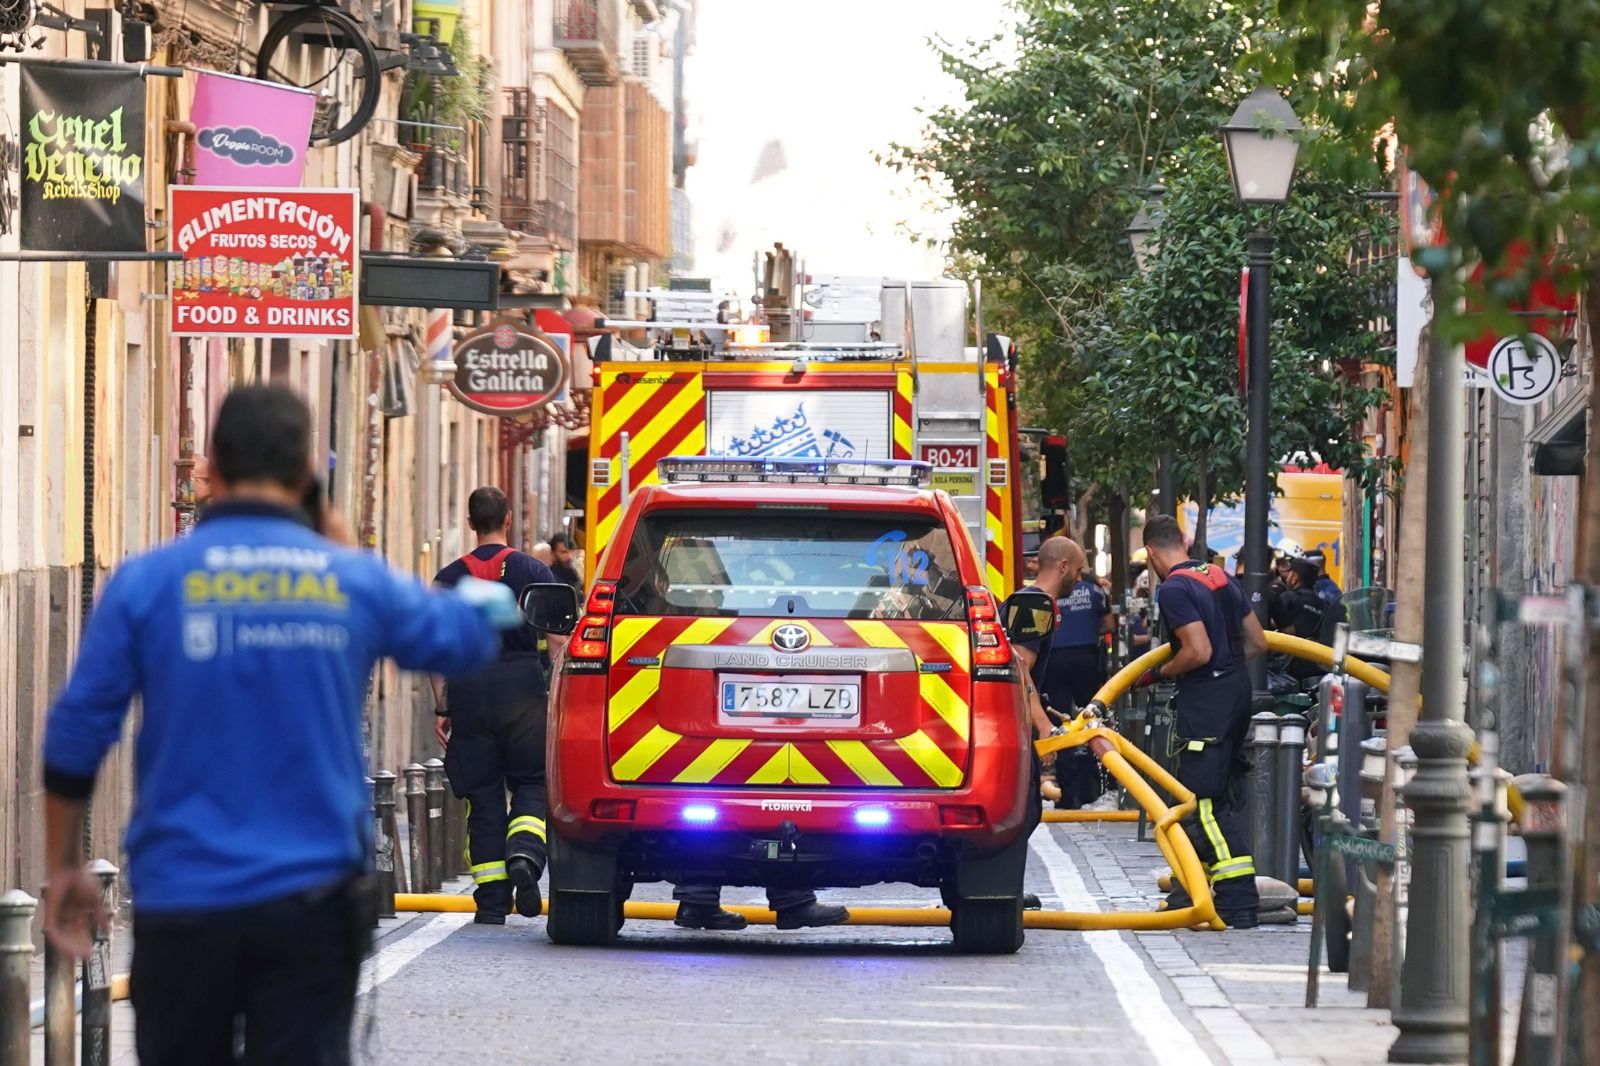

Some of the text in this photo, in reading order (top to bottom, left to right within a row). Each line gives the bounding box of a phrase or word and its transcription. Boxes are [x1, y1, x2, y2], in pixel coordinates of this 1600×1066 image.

[28, 105, 127, 152] Cruel
[24, 142, 142, 185] Veneno
[178, 197, 351, 254] ALIMENTACIÓN
[210, 233, 317, 249] FRUTOS SECOS
[177, 305, 350, 326] FOOD & DRINKS
[464, 348, 548, 370] Estrella
[468, 369, 544, 392] Galicia
[927, 448, 972, 467] BO-21
[886, 550, 929, 585] 112
[184, 570, 349, 607] SOCIAL
[236, 621, 350, 650] MADRID
[714, 653, 868, 668] LAND CRUISER
[740, 687, 799, 708] 7587
